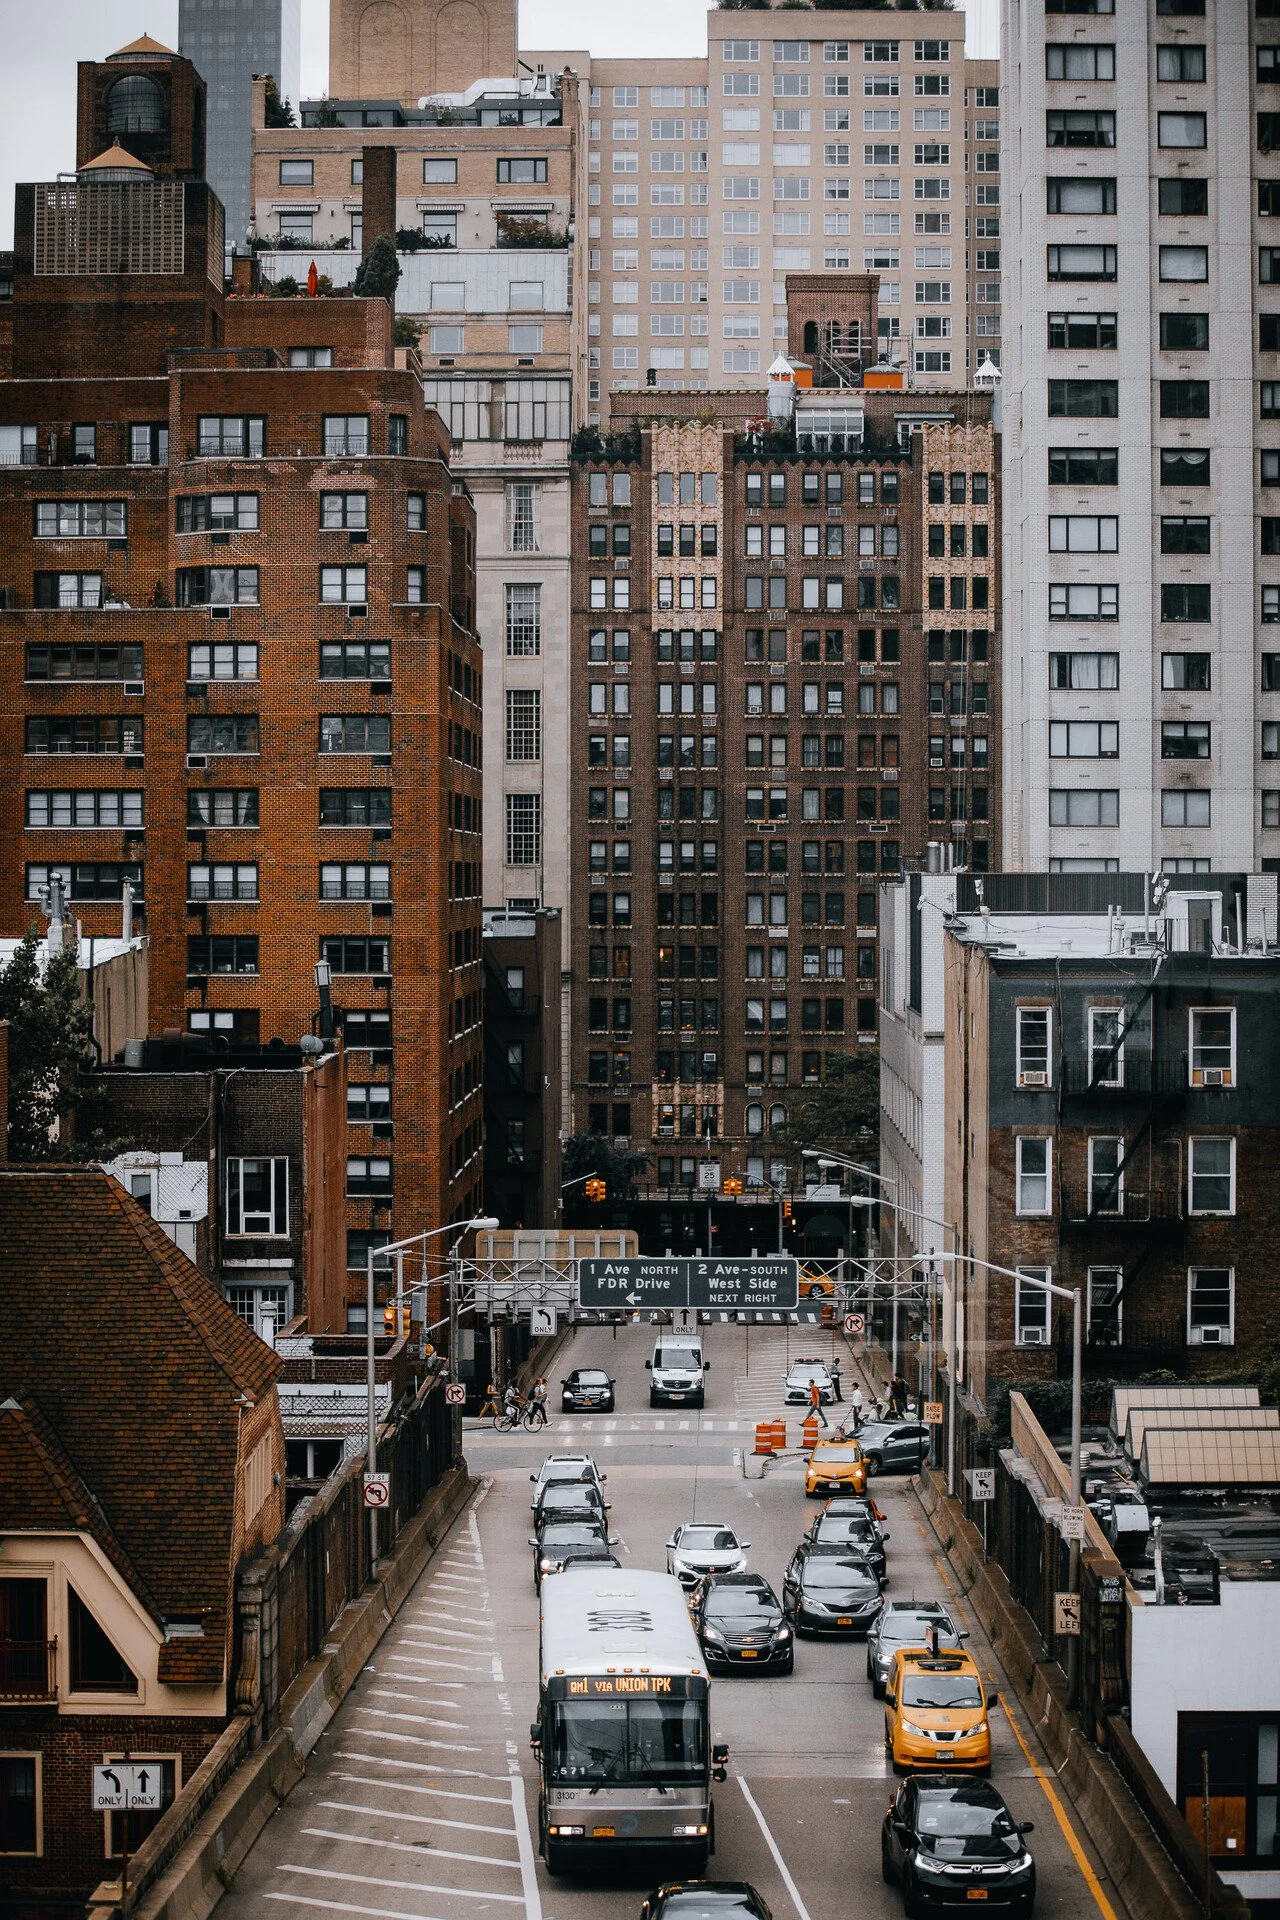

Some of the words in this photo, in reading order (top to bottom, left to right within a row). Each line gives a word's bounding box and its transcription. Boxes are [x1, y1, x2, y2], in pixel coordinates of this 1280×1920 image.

[704, 1171, 715, 1179] 25
[590, 1264, 595, 1275] 1
[604, 1264, 630, 1275] Ave
[641, 1266, 679, 1275] NORTH
[698, 1264, 708, 1275] 2
[597, 1278, 628, 1289] FDR
[635, 1278, 671, 1289] Drive
[708, 1278, 741, 1289] West
[749, 1278, 777, 1289] Side
[709, 1294, 739, 1303] NEXT
[744, 1294, 777, 1303] RIGHT
[975, 1471, 992, 1479] KEEP
[570, 1676, 589, 1693] QM1
[594, 1681, 613, 1692] VIA
[615, 1677, 649, 1692] UNION
[651, 1677, 672, 1692] TPK
[98, 1796, 122, 1805] ONLY
[131, 1796, 156, 1805] ONLY
[557, 1791, 575, 1800] 3130
